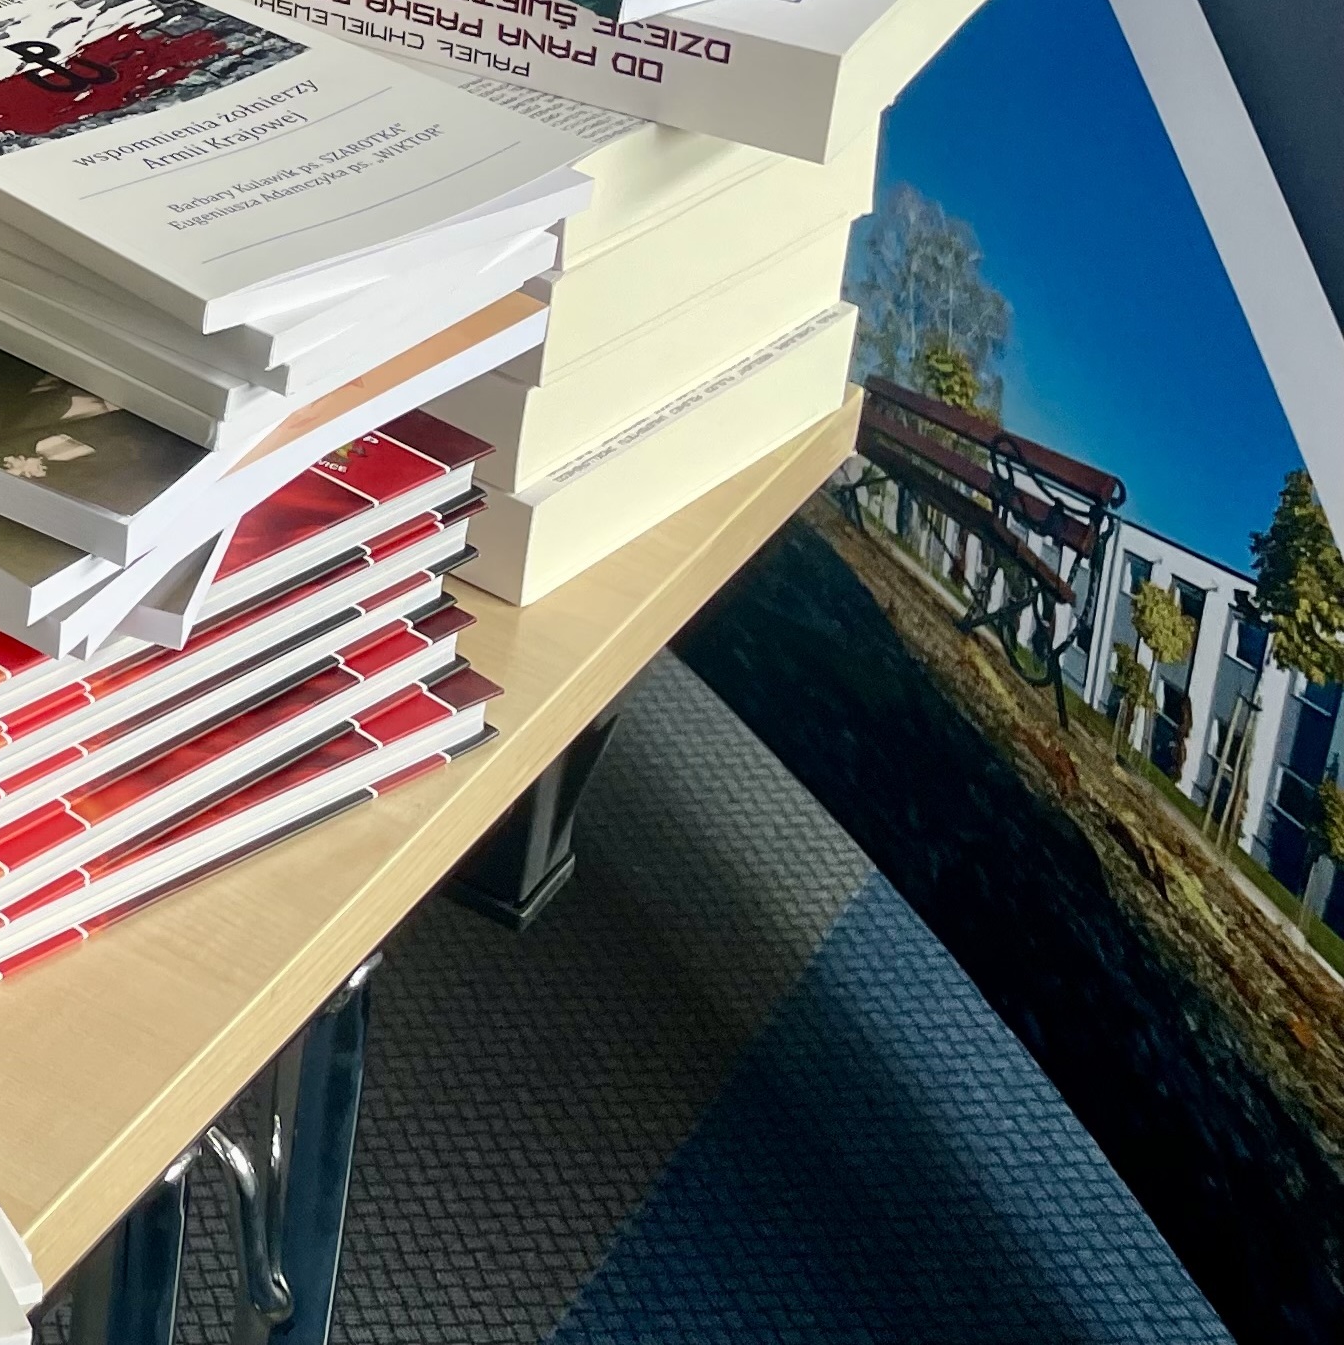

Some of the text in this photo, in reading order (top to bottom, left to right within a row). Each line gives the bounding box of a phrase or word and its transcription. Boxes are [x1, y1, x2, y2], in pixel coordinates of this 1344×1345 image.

[435, 38, 532, 78] PAWEŁ
[497, 25, 599, 67] PANA
[611, 52, 665, 83] OD
[72, 76, 319, 173] wspomnienia żołnierzy
[141, 108, 310, 172] Armii Krajowej
[167, 160, 322, 215] Barbary Kulawik ps.
[167, 196, 262, 232] Eugeniusza
[261, 168, 349, 205] Adamczyka
[347, 158, 373, 179] ps.
